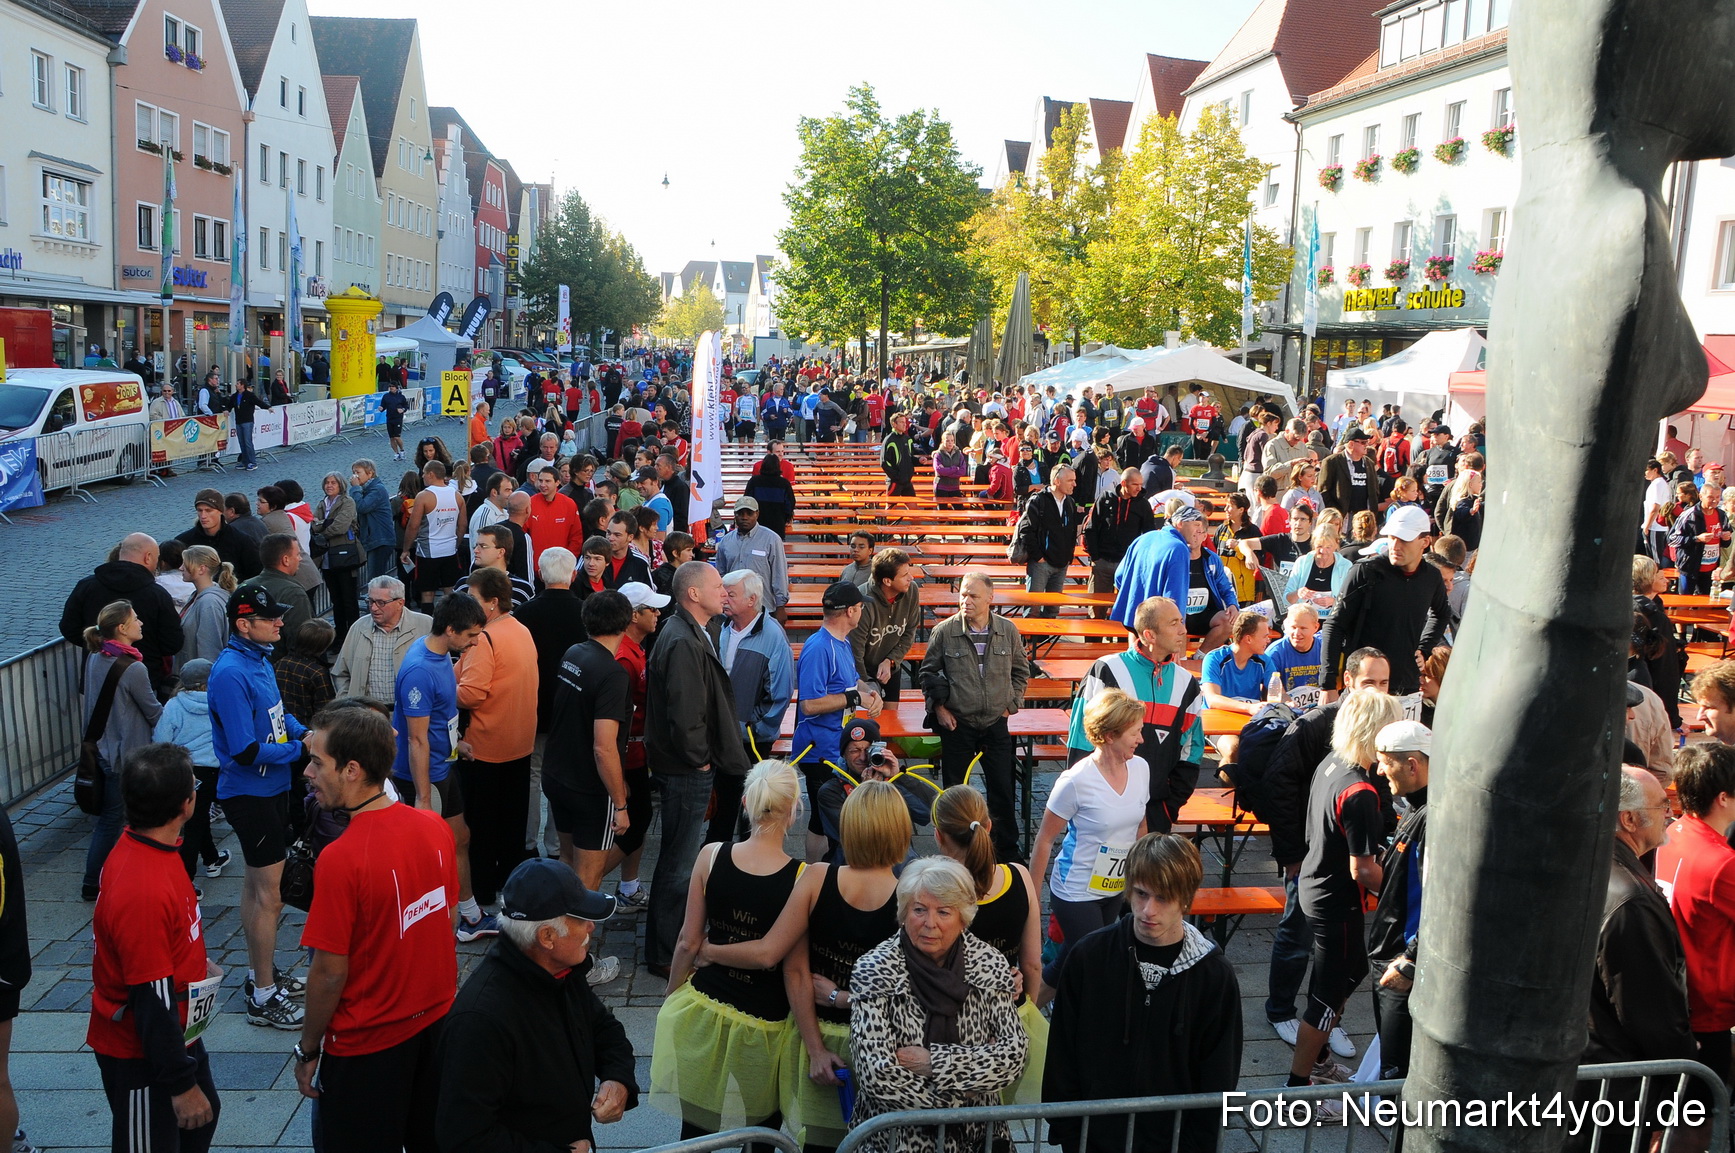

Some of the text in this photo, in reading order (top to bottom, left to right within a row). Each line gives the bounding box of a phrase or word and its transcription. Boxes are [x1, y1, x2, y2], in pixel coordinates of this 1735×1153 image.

[507, 234, 519, 296] HOTEL
[1344, 282, 1465, 312] mayer schuhe
[462, 305, 487, 340] THULE
[444, 373, 469, 381] Block
[447, 384, 465, 406] A
[869, 617, 907, 648] Sport
[1294, 690, 1320, 708] 3249
[408, 899, 430, 920] DEHN
[733, 908, 758, 925] Wir
[728, 968, 754, 985] aus.
